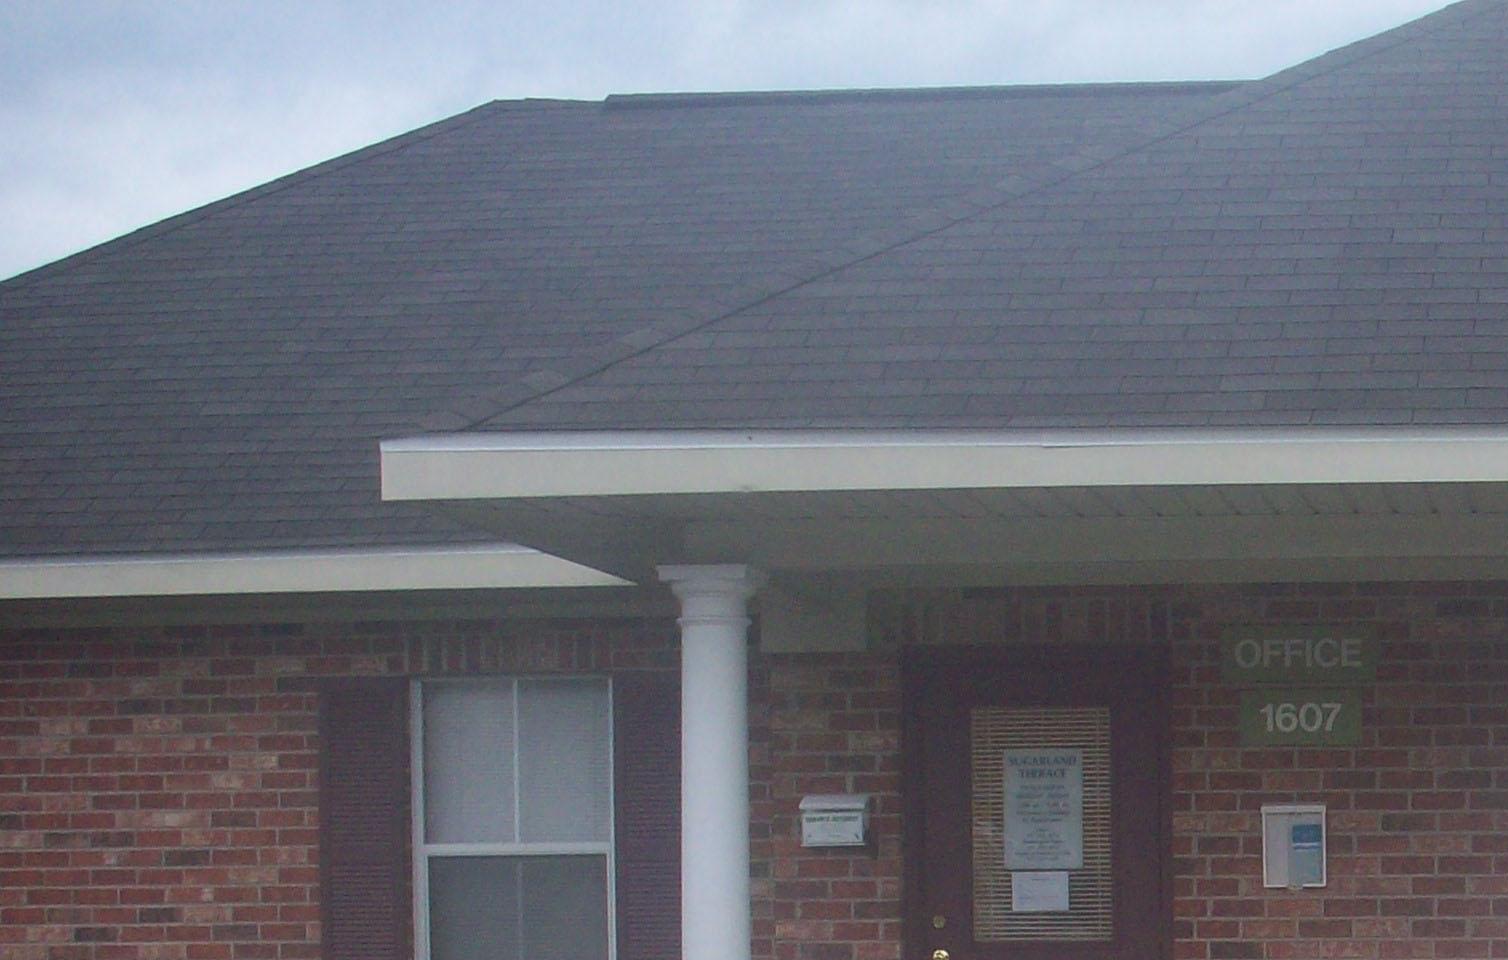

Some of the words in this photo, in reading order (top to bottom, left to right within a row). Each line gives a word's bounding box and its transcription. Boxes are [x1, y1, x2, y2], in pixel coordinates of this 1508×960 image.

[1235, 639, 1363, 668] OFFICE
[1260, 702, 1343, 733] 1607
[1018, 767, 1067, 778] TERRACE
